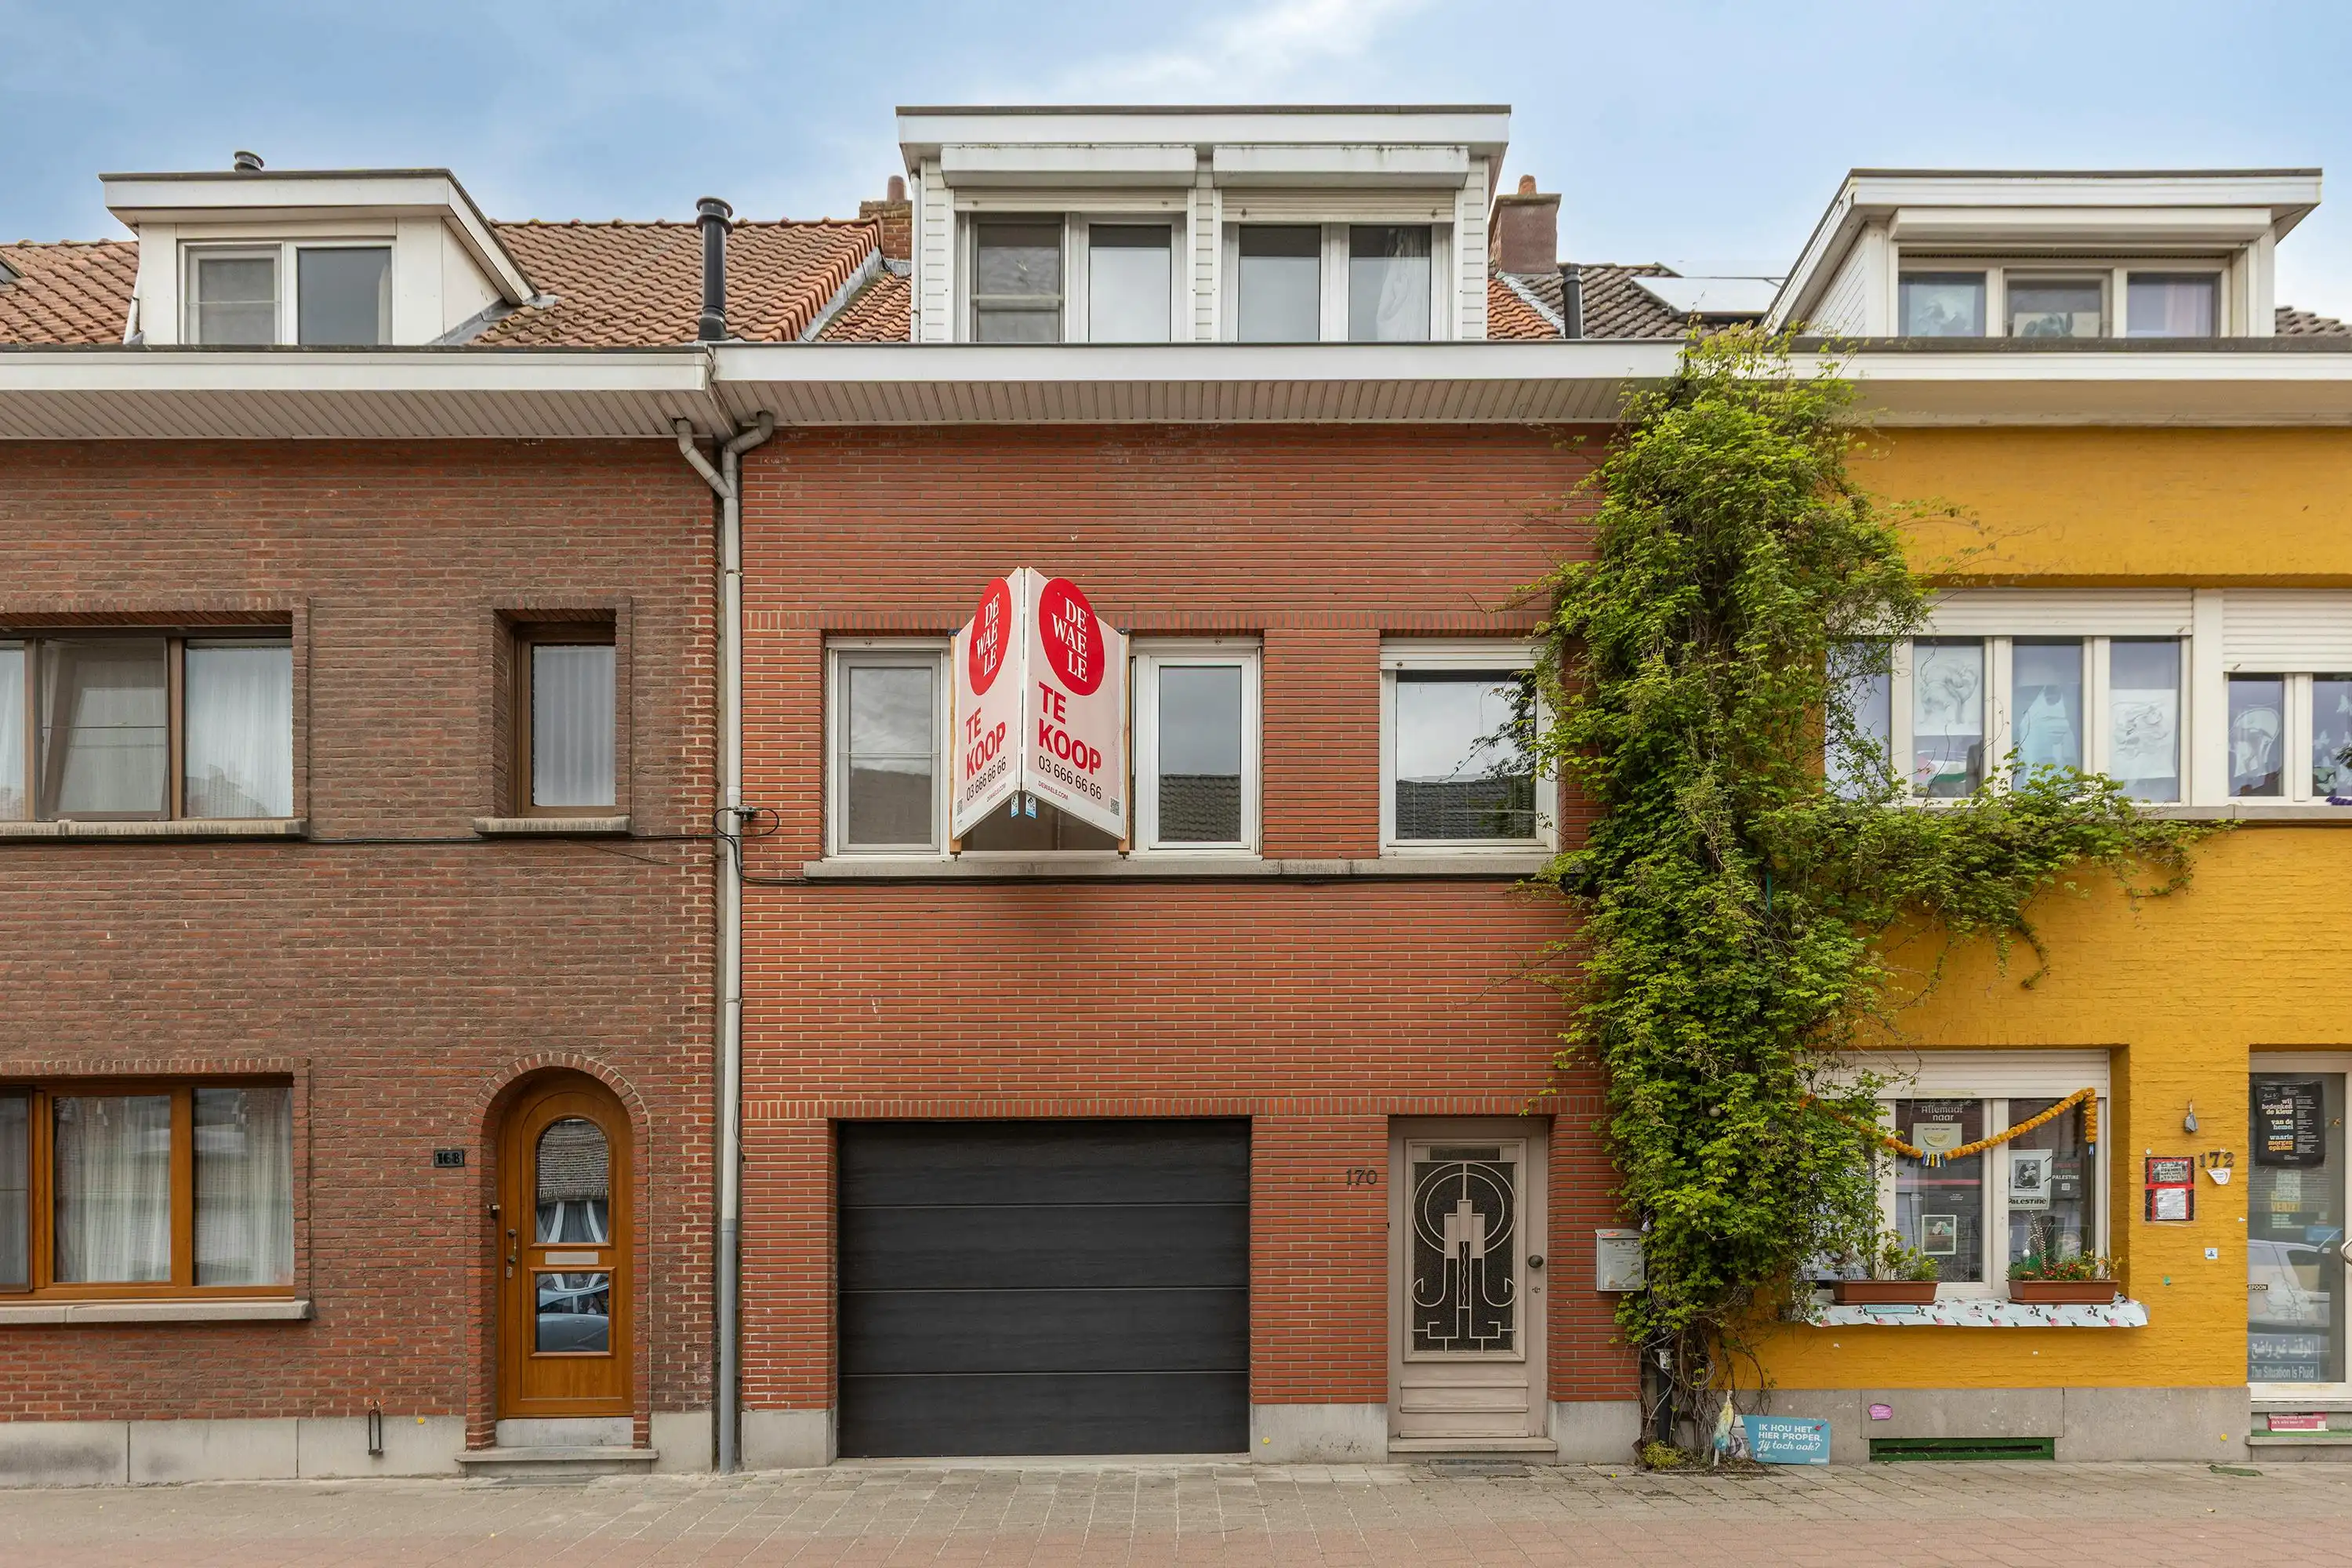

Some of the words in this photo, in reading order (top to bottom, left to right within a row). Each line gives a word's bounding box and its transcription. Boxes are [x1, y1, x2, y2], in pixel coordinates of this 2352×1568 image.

[985, 593, 1000, 628] DE
[1065, 597, 1087, 633] DE
[976, 618, 999, 659] WAE
[1051, 612, 1087, 658] WAE
[983, 644, 997, 677] LE
[1067, 649, 1087, 682] LE
[1039, 681, 1066, 724] TE
[966, 706, 982, 744] TE
[966, 721, 1006, 780] KOOP
[1039, 718, 1102, 775] KOOP
[966, 784, 975, 800] 03
[975, 772, 987, 793] 666
[988, 764, 996, 783] 66
[997, 756, 1006, 775] 66
[1038, 780, 1069, 800] DEWAELE.COM
[1039, 755, 1051, 774] 03
[1054, 764, 1073, 785] 666
[1075, 775, 1087, 793] 66
[1090, 782, 1102, 800] 66
[437, 1152, 459, 1164] 168
[2199, 1152, 2234, 1167] 172
[1346, 1168, 1377, 1185] 170
[2251, 1366, 2263, 1377] The
[2263, 1366, 2289, 1377] Situation
[2292, 1367, 2297, 1377] Is
[2299, 1366, 2314, 1378] Fluid
[1756, 1439, 1770, 1451] Jij
[1773, 1440, 1795, 1450] toch
[1795, 1442, 1820, 1451] ook?
[1771, 1424, 1791, 1432] HOU
[1782, 1433, 1823, 1442] PROPER.
